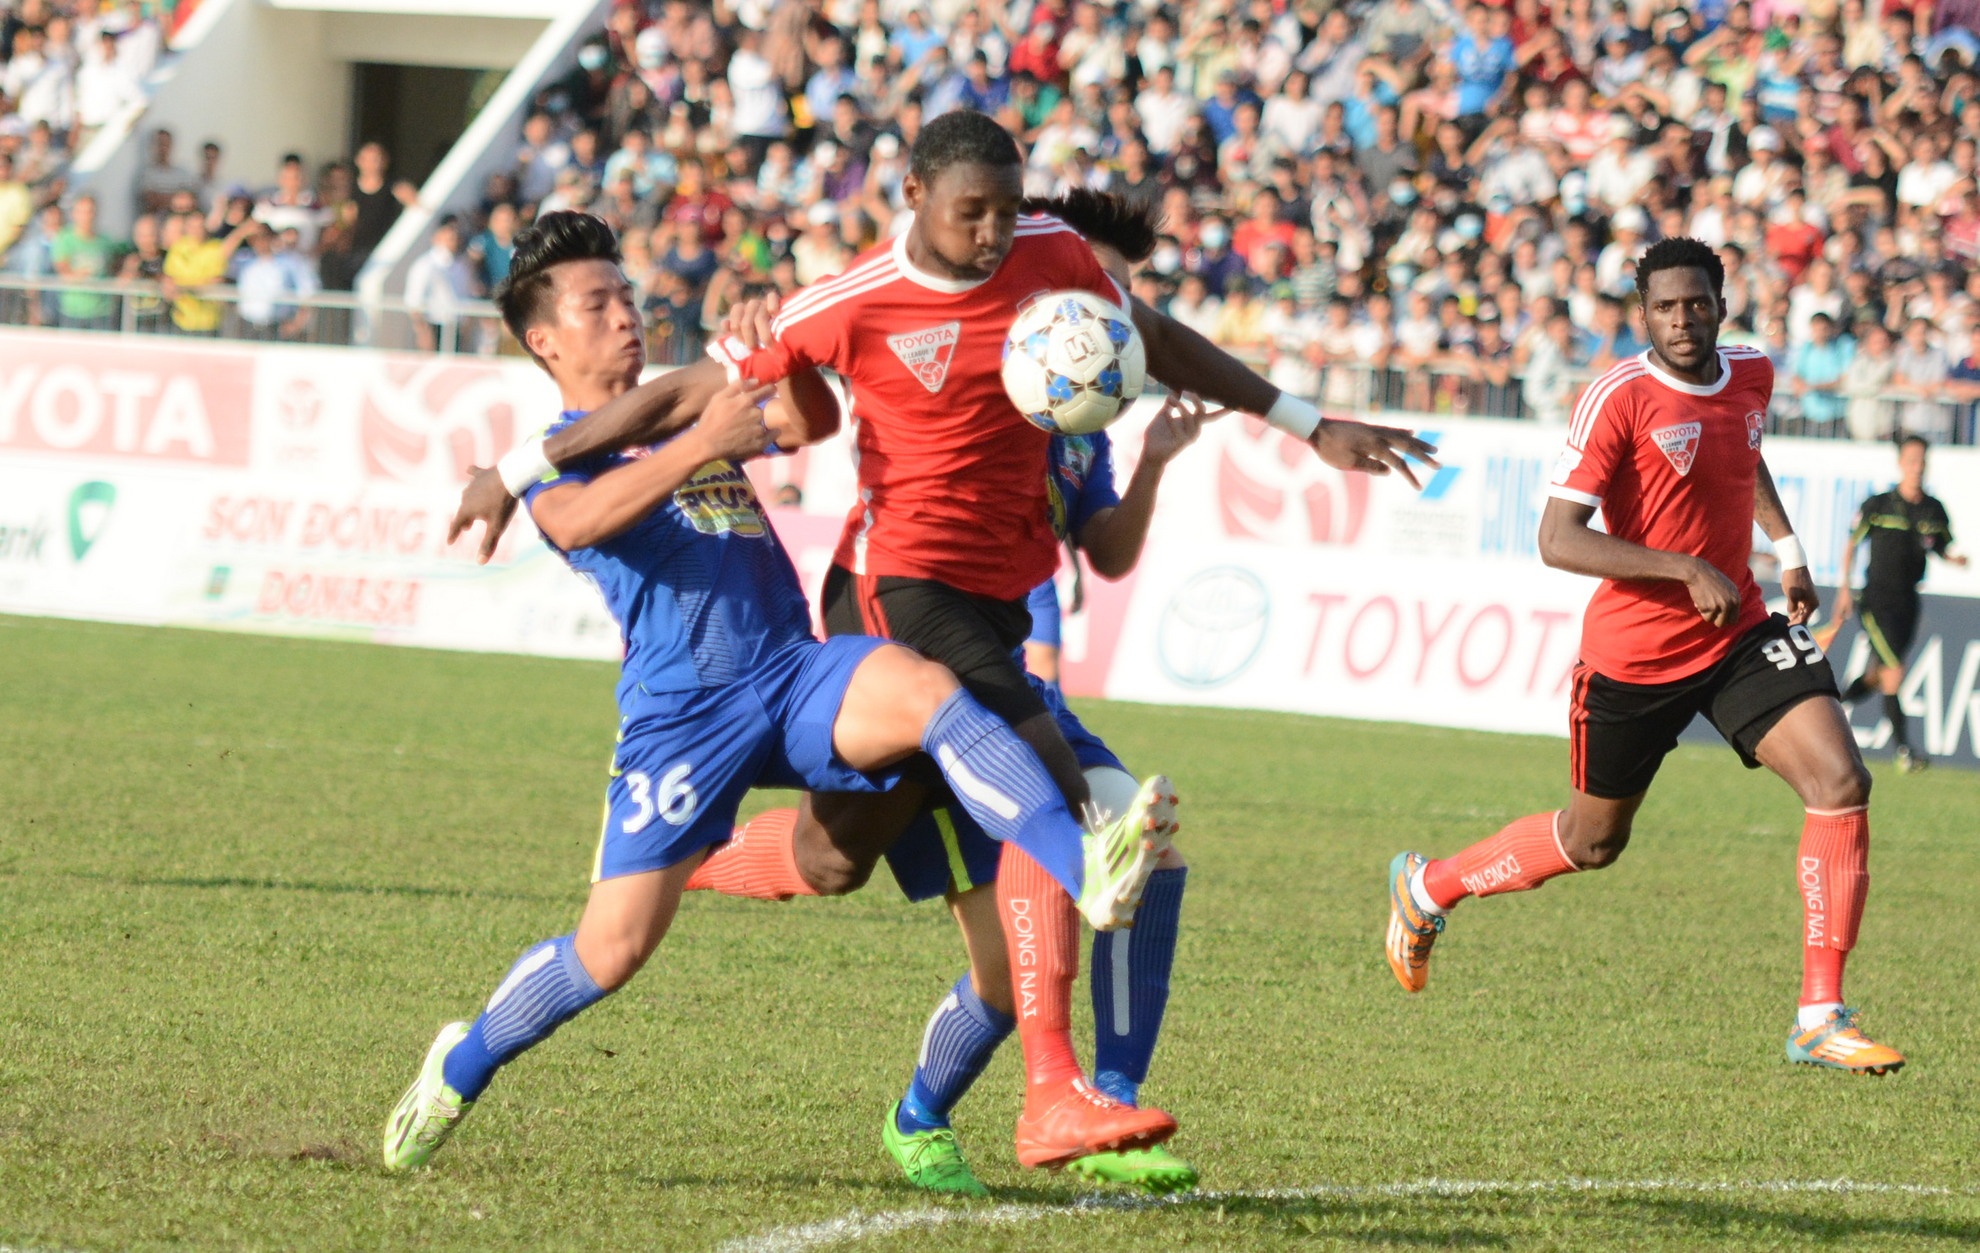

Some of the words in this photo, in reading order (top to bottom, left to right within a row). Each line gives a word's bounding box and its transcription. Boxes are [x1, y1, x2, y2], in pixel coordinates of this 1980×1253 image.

[893, 329, 954, 351] TOYOTA
[1656, 426, 1699, 441] TOYOTA
[1302, 592, 1579, 697] TOYOT
[1761, 624, 1824, 671] 99
[622, 763, 698, 834] 36
[1461, 871, 1488, 893] NAI
[1483, 853, 1522, 887] DONG
[1801, 856, 1824, 911] DONG
[1010, 899, 1037, 966] DONG
[1807, 913, 1825, 948] NAI
[1019, 972, 1038, 1020] NAI
